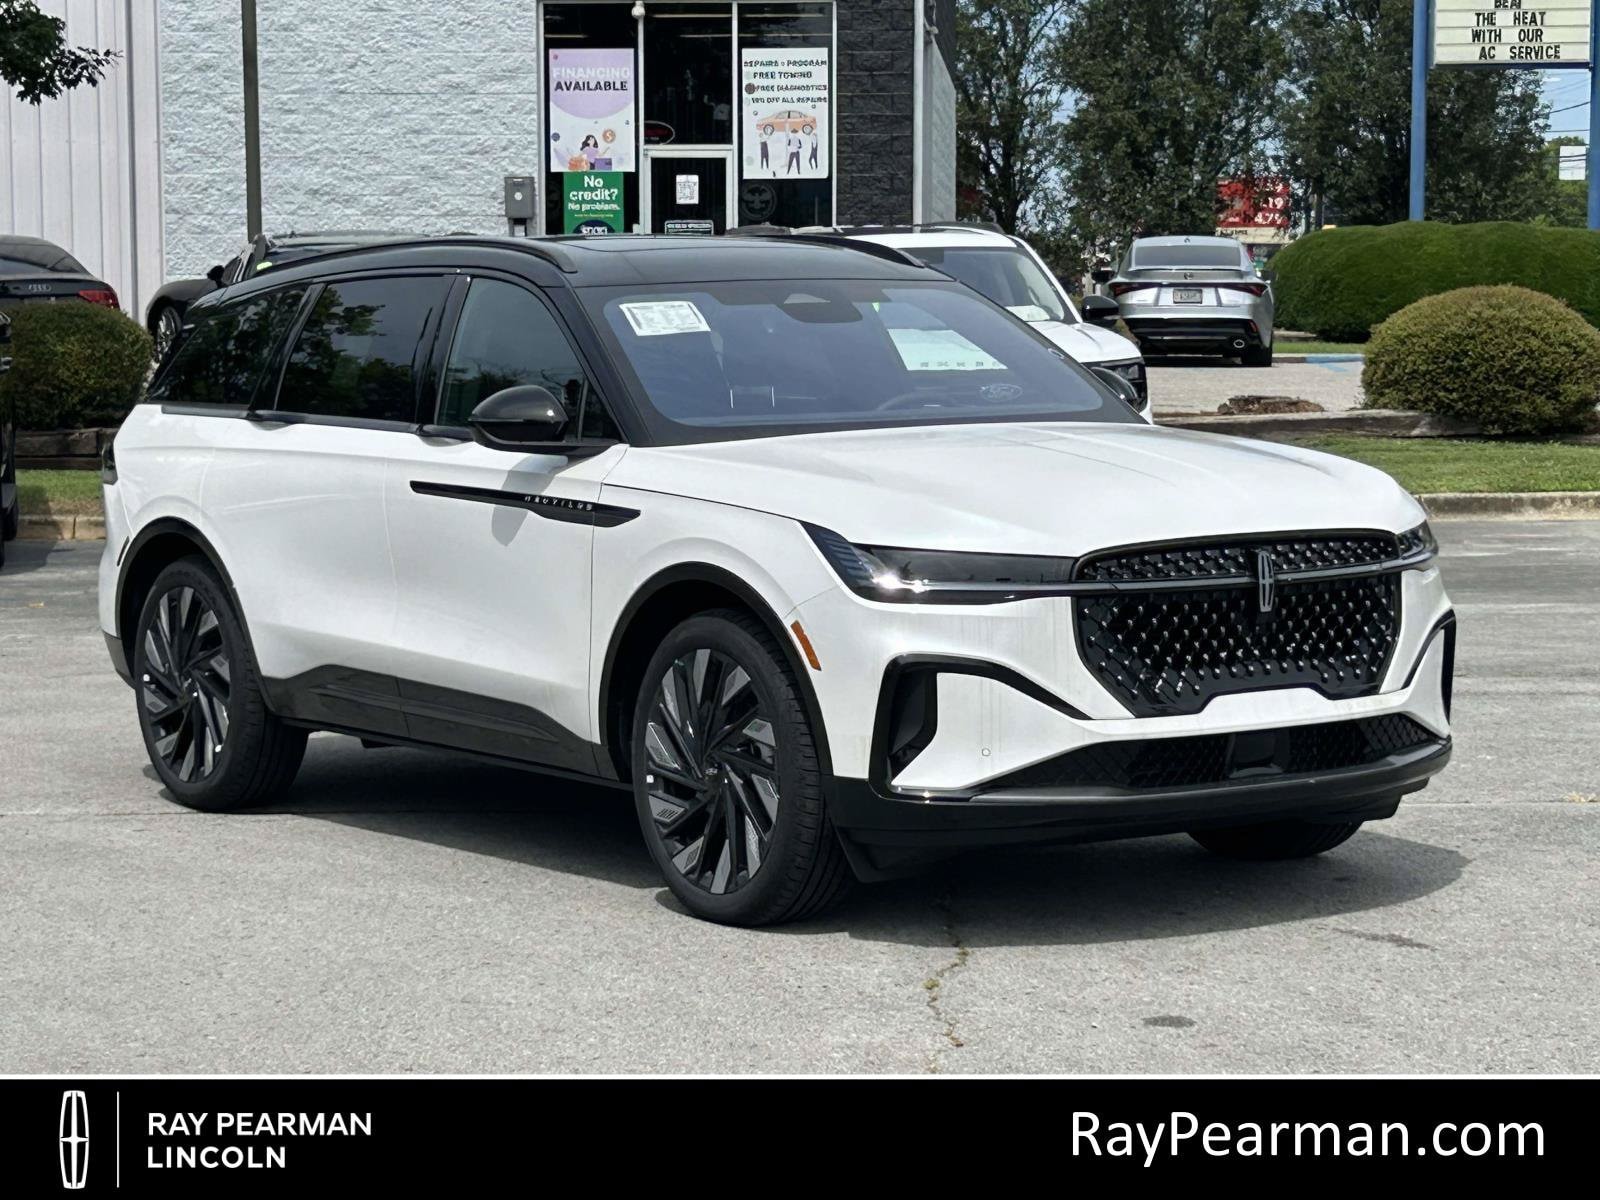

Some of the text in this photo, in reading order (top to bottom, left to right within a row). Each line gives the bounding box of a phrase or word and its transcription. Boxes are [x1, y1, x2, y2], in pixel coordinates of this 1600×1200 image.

[1475, 11, 1546, 27] THE HEAT
[1471, 28, 1543, 43] WITH OUR
[1479, 44, 1560, 60] AC SERVICE
[552, 67, 630, 79] FINANCING
[554, 81, 628, 91] AVAILABLE
[584, 175, 604, 188] No
[569, 188, 618, 201] credit?
